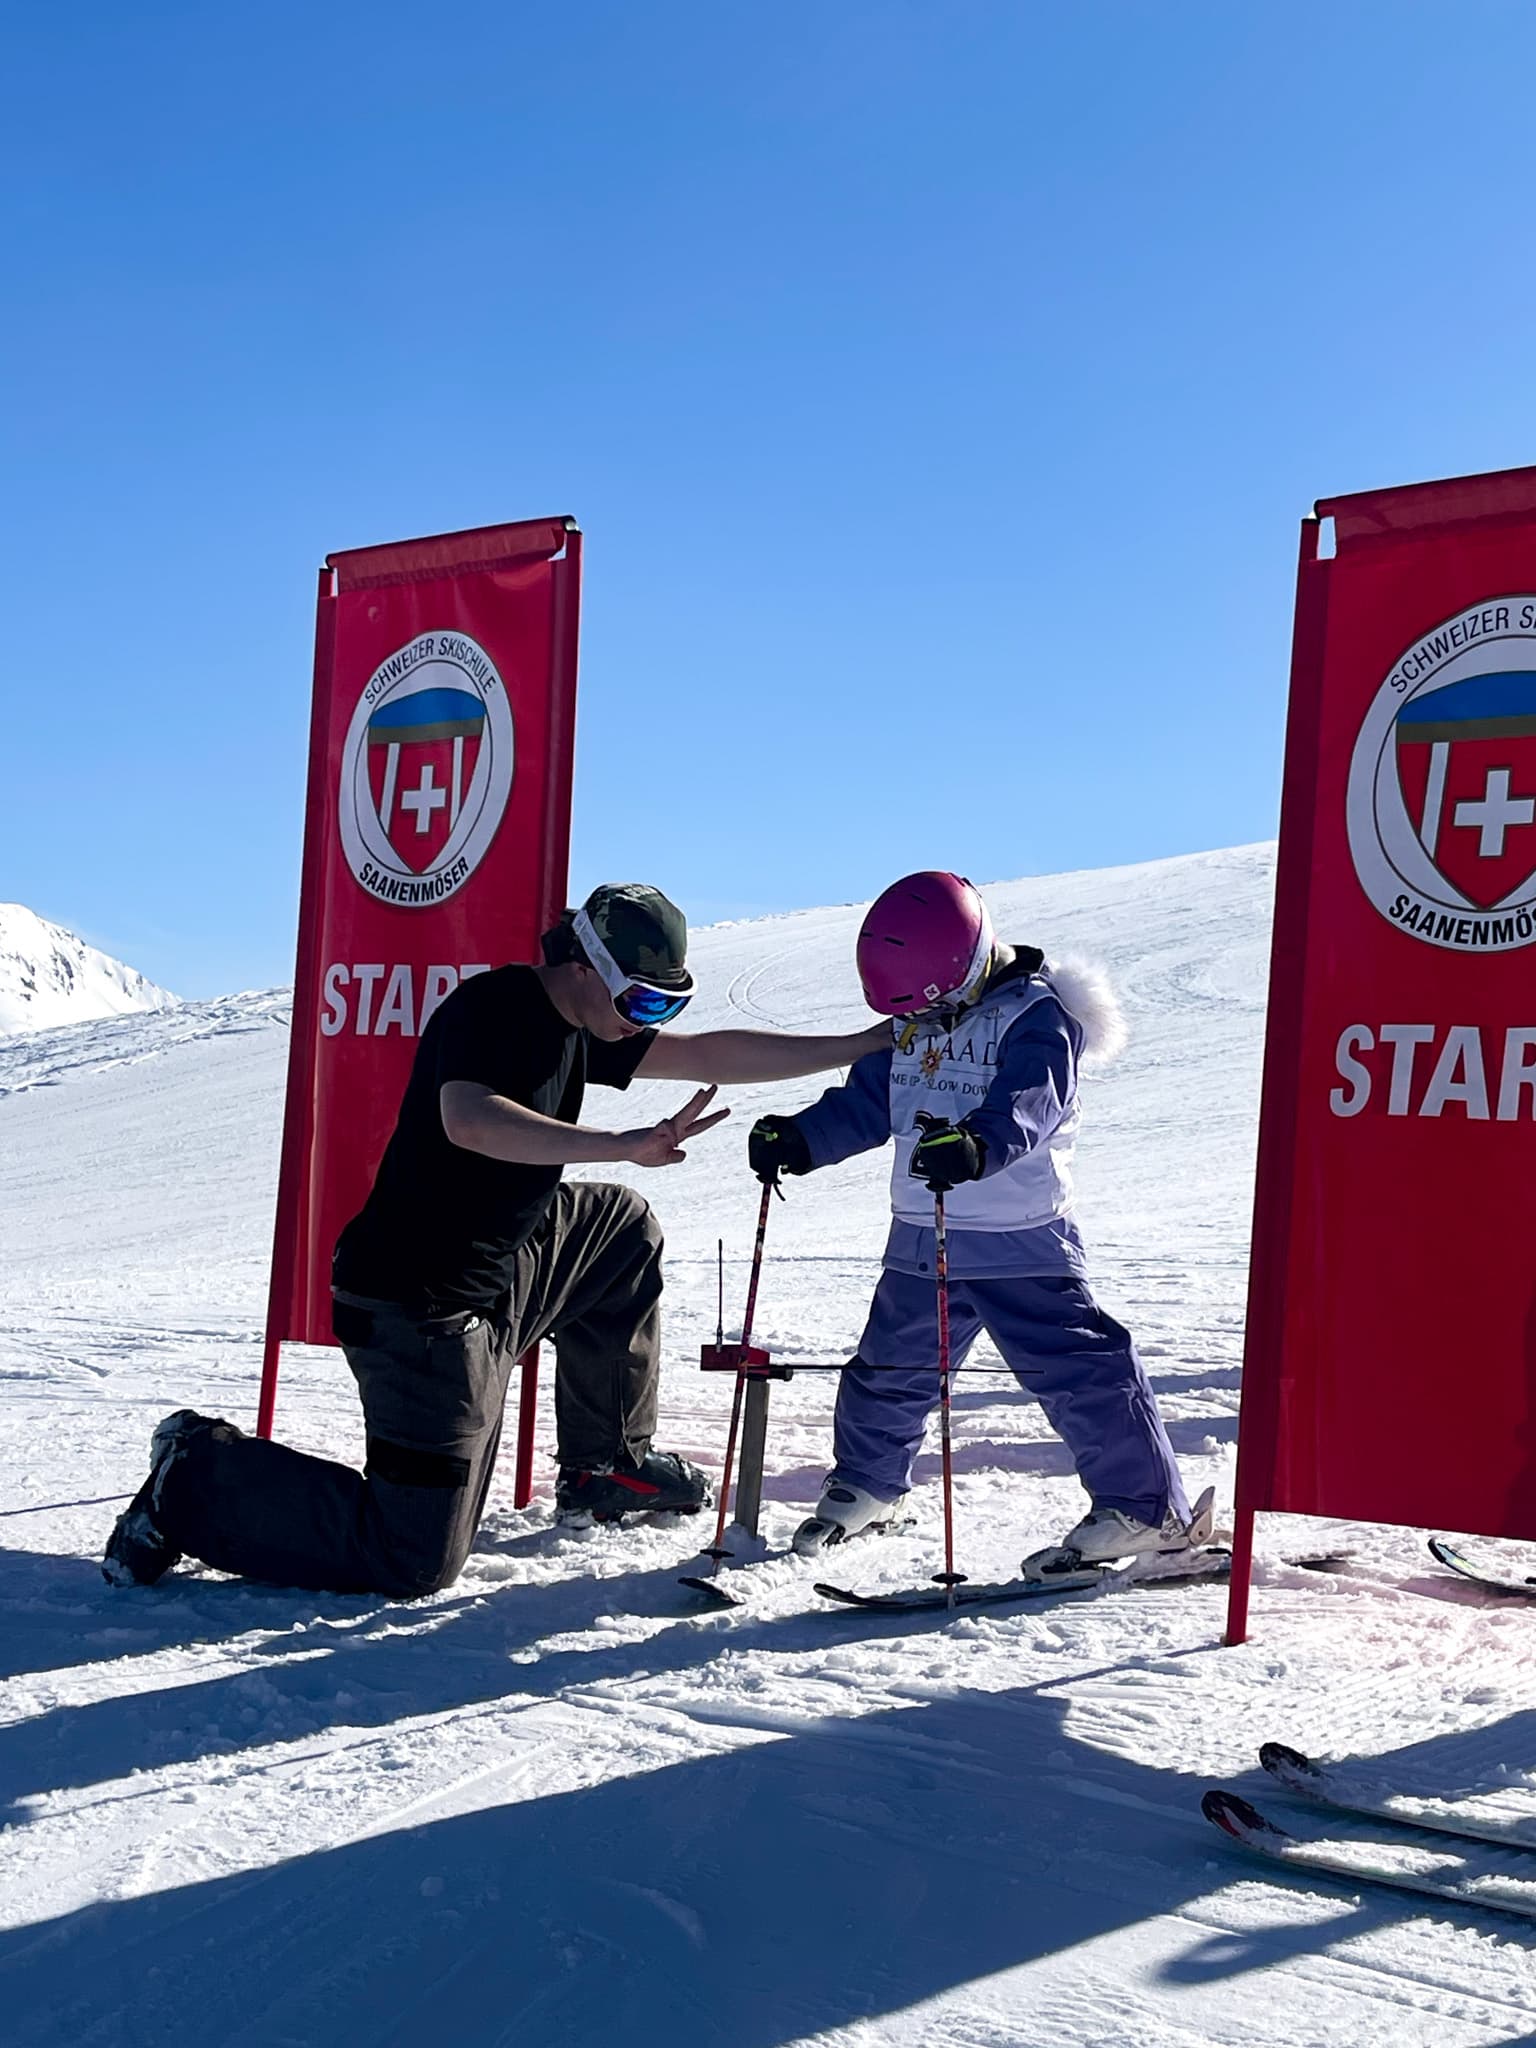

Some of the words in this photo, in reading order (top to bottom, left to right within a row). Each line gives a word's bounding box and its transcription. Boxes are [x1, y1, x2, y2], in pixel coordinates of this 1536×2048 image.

[364, 637, 435, 705] SCHWEIZER
[438, 636, 497, 695] SKISCHULE
[1389, 606, 1510, 695] SCHWEIZER
[359, 855, 470, 903] SAANENMÖSER
[1388, 894, 1536, 946] SAANENMÖ
[320, 962, 492, 1037] STAR
